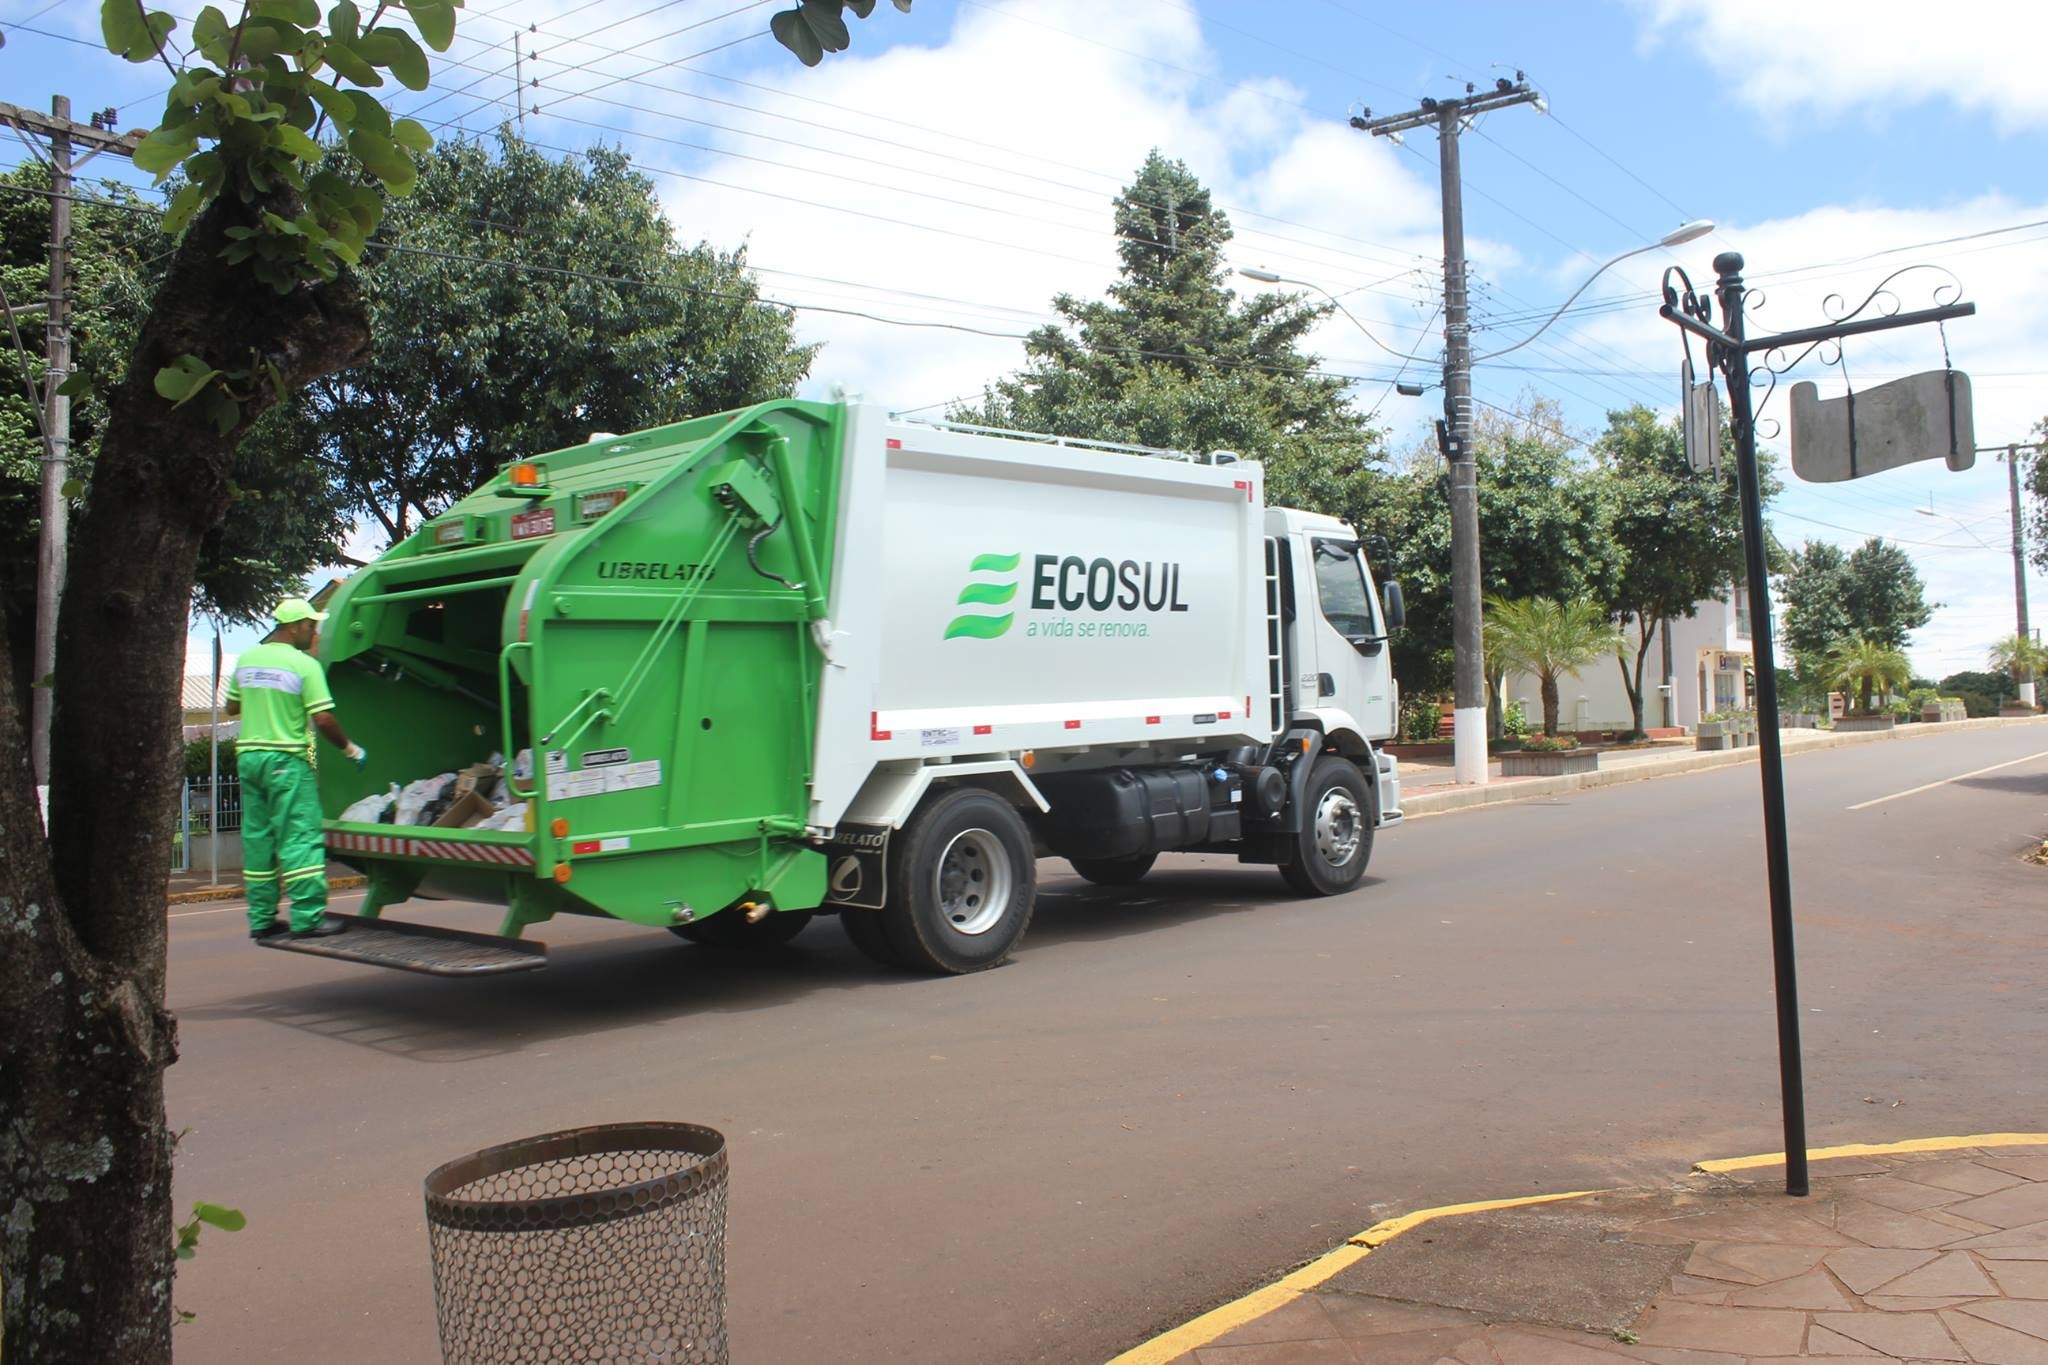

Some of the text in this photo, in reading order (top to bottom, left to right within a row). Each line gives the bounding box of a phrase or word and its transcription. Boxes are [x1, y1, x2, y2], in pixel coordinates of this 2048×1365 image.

[597, 561, 715, 581] LIBRELATO
[1031, 554, 1189, 612] ECOSUL
[1026, 616, 1150, 637] a vida se renova.
